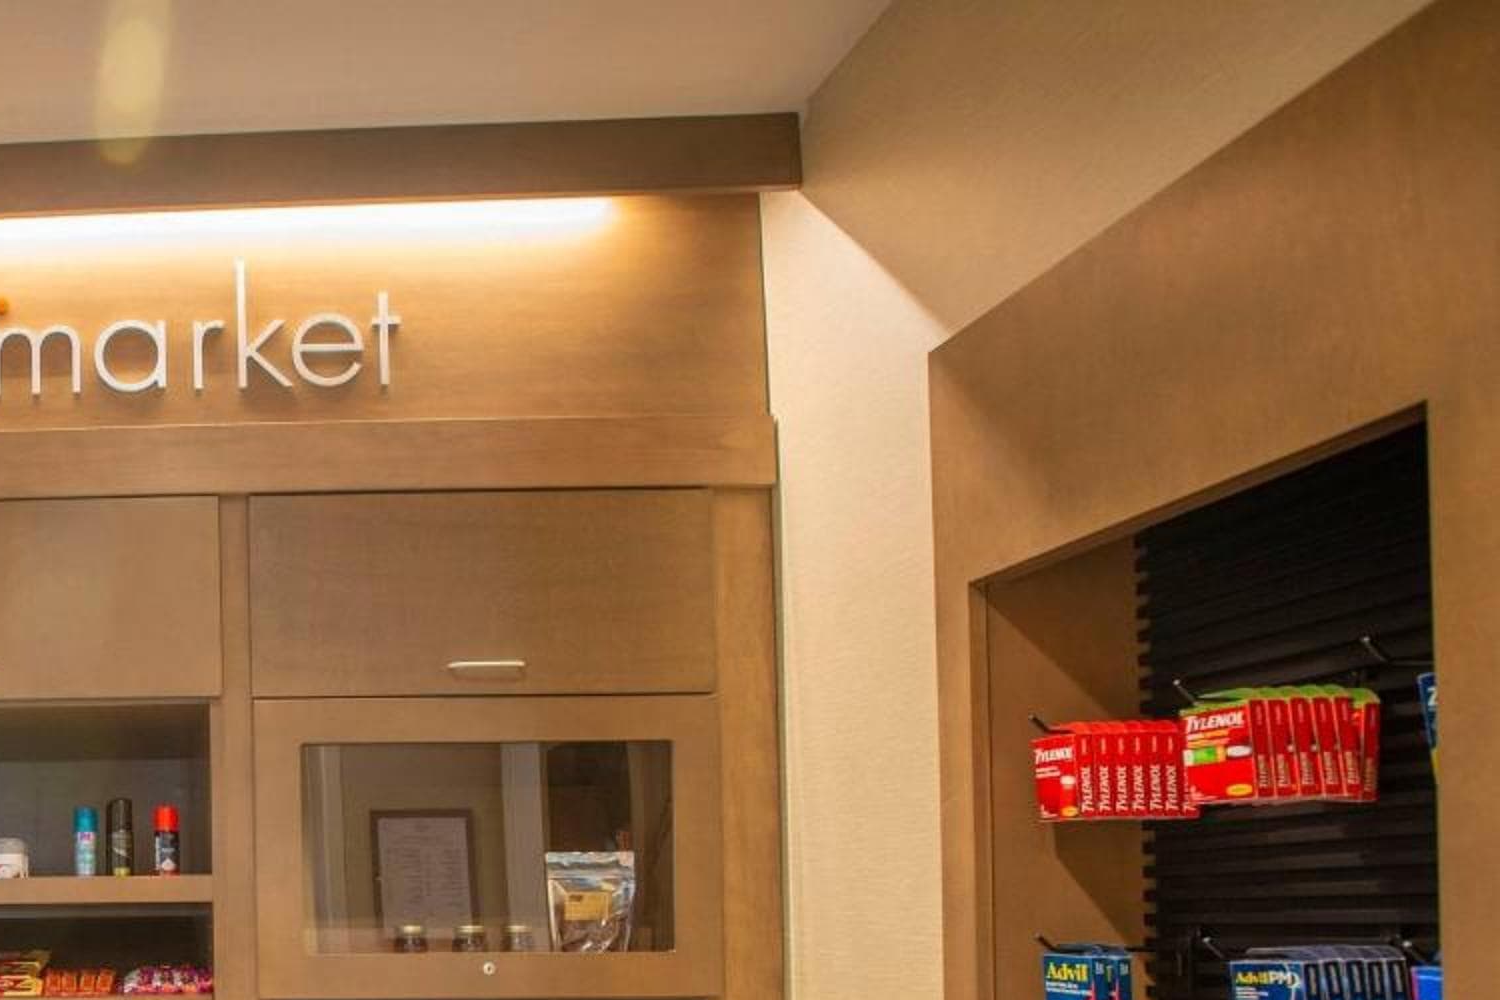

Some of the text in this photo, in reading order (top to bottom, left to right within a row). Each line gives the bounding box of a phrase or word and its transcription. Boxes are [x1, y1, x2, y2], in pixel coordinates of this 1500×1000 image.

[1186, 711, 1246, 732] TYLENOL
[1034, 747, 1074, 764] TYLENOL
[1045, 962, 1088, 982] Advil
